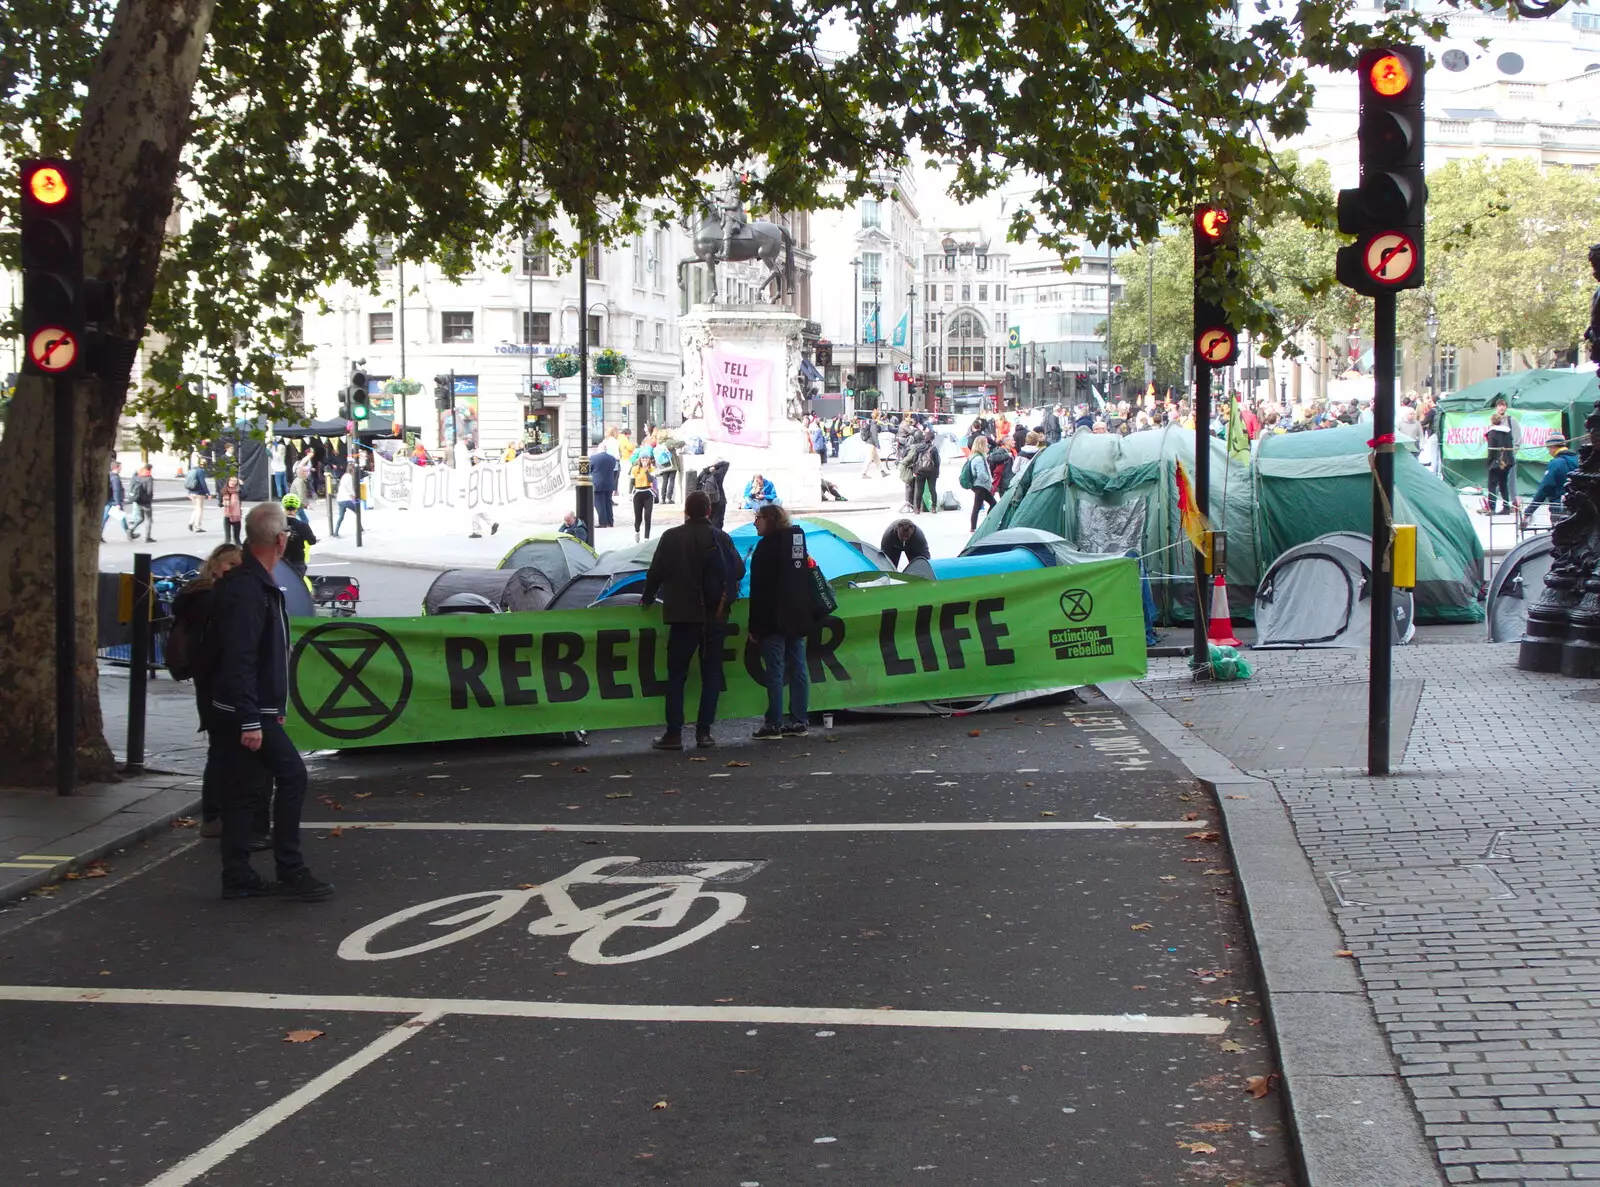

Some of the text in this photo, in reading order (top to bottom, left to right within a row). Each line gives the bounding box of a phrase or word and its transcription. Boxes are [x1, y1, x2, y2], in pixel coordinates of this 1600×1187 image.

[494, 346, 539, 354] TOURISM
[724, 361, 748, 377] TELL
[730, 377, 741, 385] THE
[716, 383, 753, 402] TRUTH
[423, 468, 455, 508] OIL
[468, 465, 518, 509] BOIL
[820, 591, 833, 609] BOOKS
[1052, 628, 1099, 643] extinction
[445, 627, 668, 709] REBEL
[880, 597, 1015, 676] LIFE
[1068, 641, 1112, 657] rebellion
